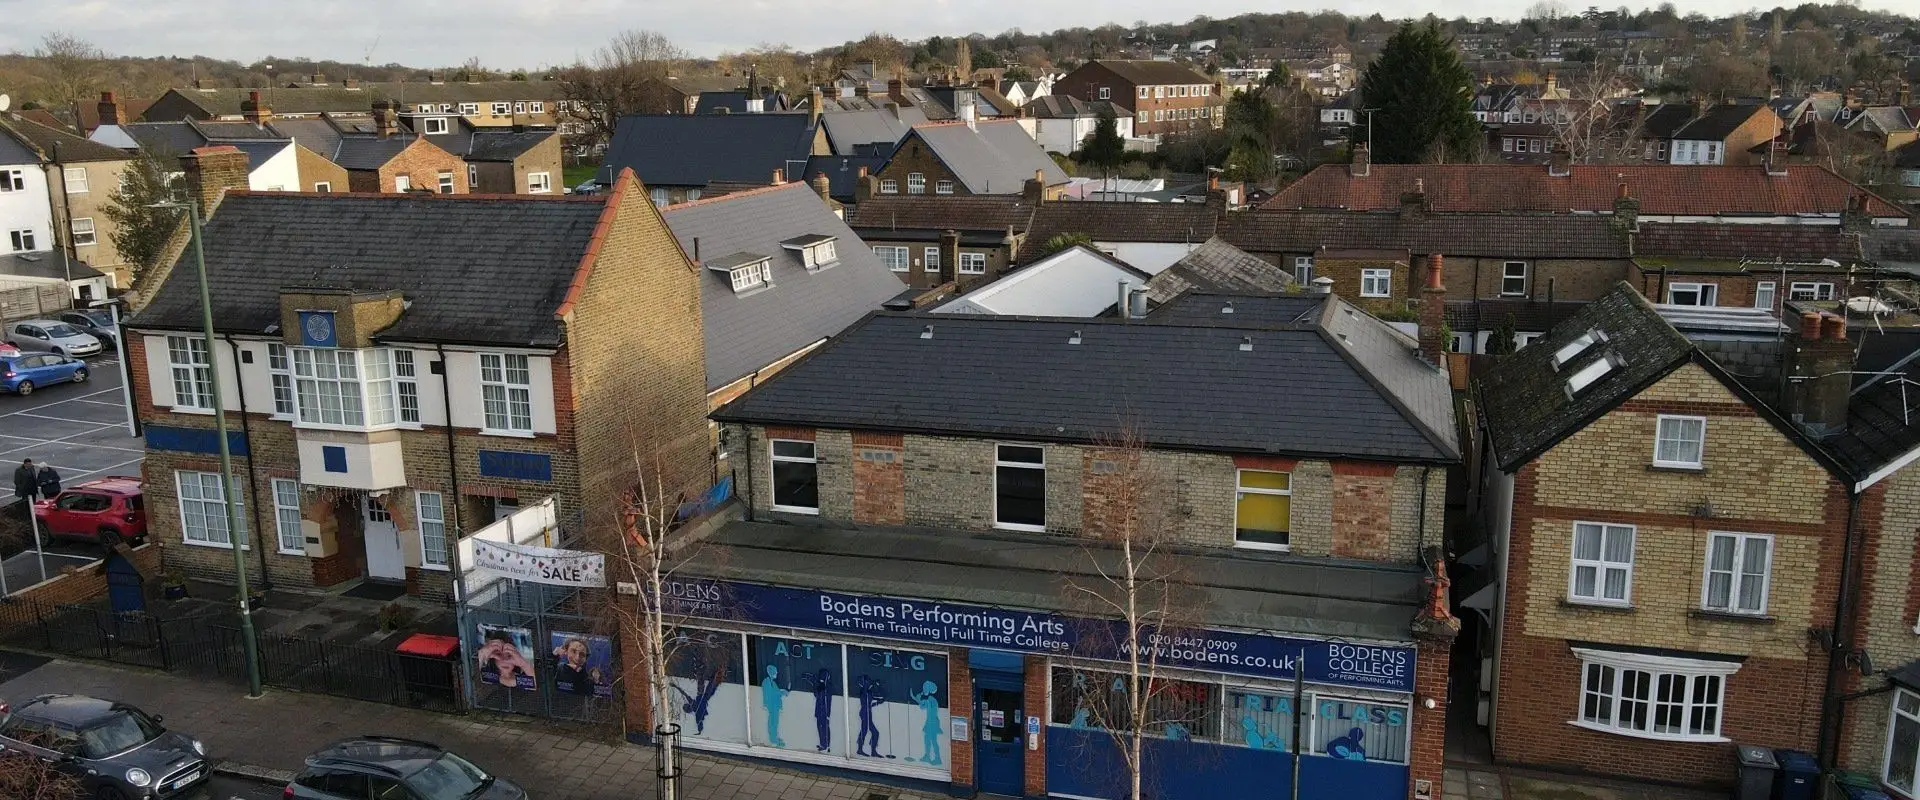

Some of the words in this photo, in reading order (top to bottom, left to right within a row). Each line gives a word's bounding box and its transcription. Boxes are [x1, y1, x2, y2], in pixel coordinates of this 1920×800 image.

[542, 566, 582, 582] SALE
[820, 595, 895, 618] Bodens
[901, 603, 1015, 634] Performing
[1021, 615, 1064, 635] Arts
[826, 614, 850, 628] Part
[852, 617, 885, 632] Time
[888, 621, 940, 639] Training
[951, 628, 974, 641] Full
[977, 630, 1011, 645] Time
[1015, 634, 1069, 651] College
[1149, 634, 1171, 645] 020
[1174, 636, 1203, 648] 8447
[1207, 639, 1237, 651] 0909
[774, 641, 815, 660] ACT
[1329, 644, 1406, 665] BODENS
[1328, 658, 1405, 678] COLLEGE
[1339, 673, 1385, 685] PERFORMING
[1386, 678, 1404, 687] ARTS
[1229, 692, 1293, 715] TRIA
[1319, 701, 1404, 727] CLASS
